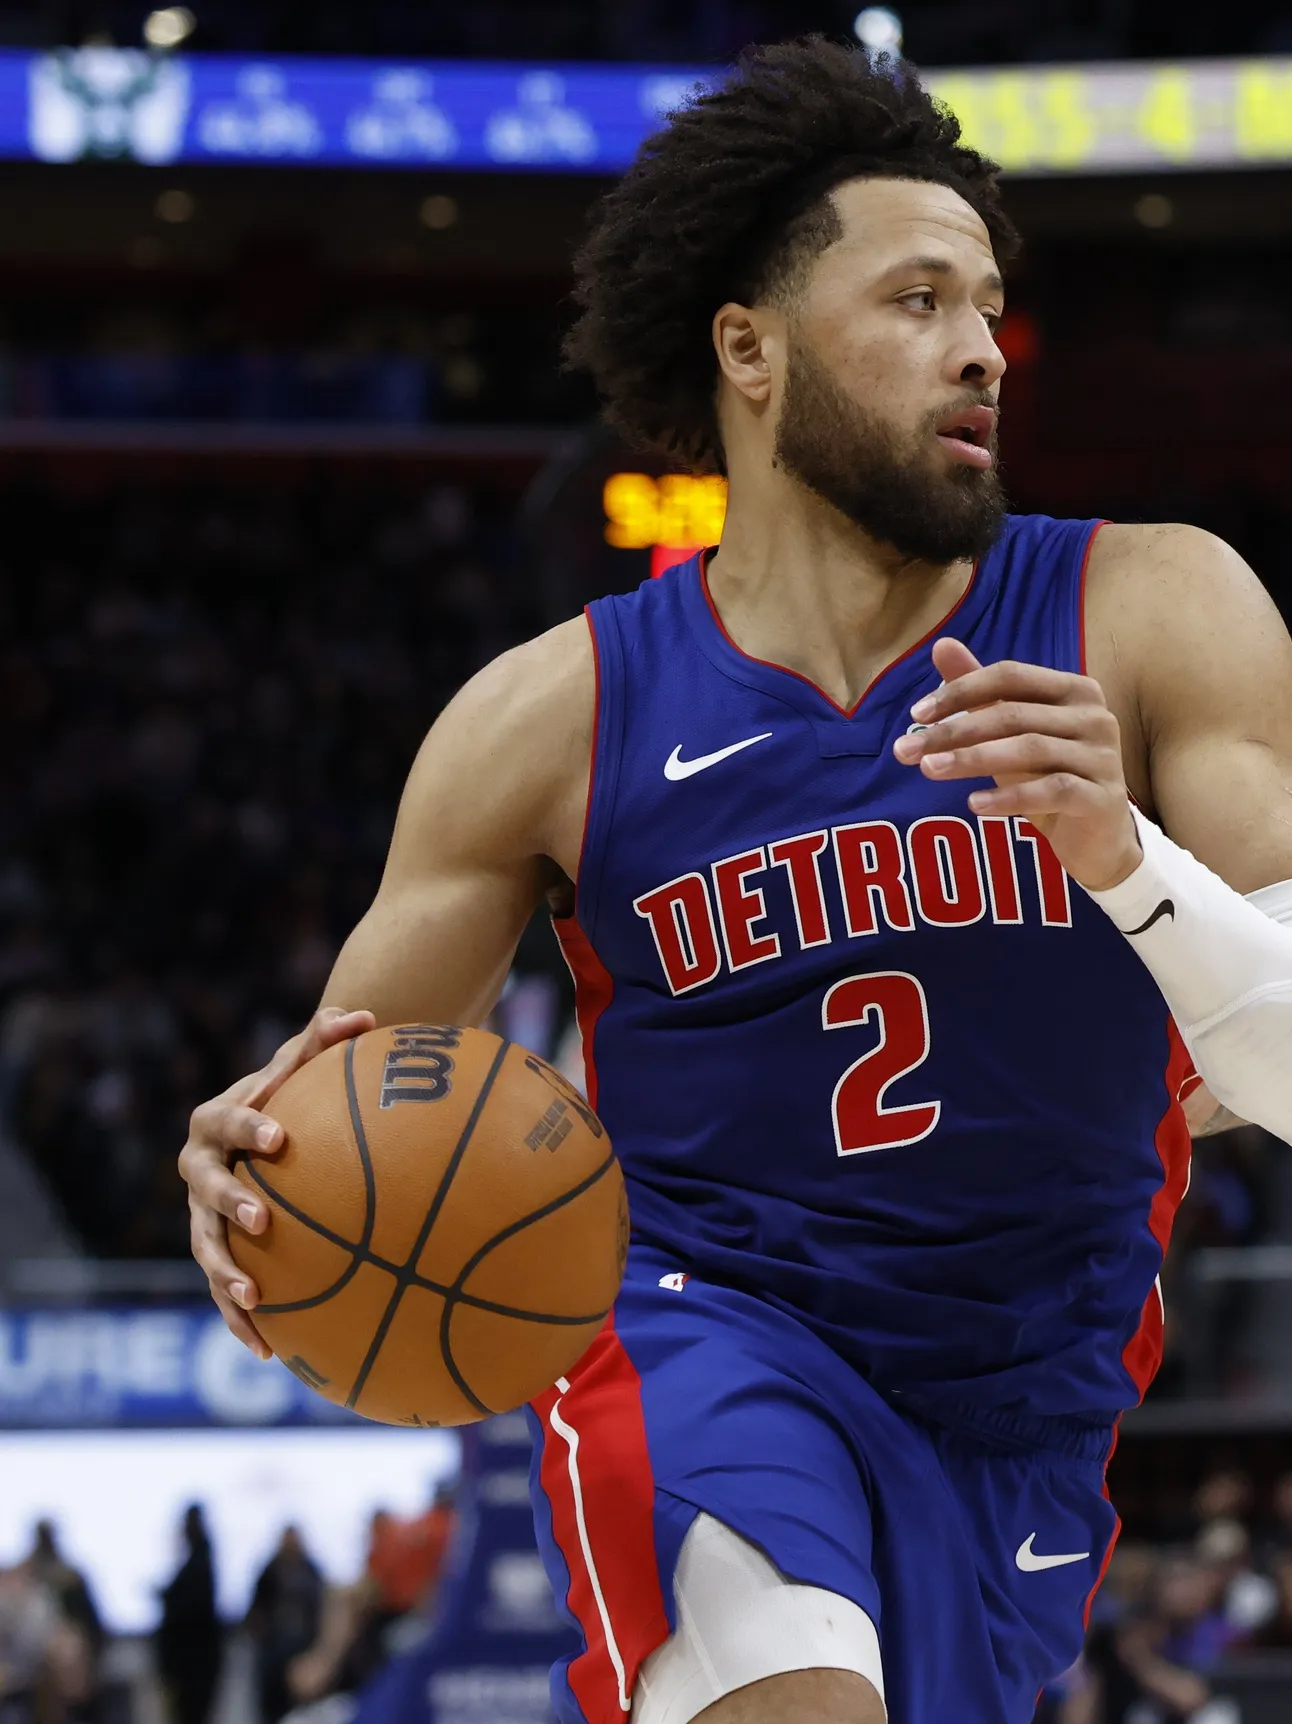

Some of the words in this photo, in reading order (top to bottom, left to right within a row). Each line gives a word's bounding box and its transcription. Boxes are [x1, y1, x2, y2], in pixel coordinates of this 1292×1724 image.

[633, 815, 1073, 997] DETROIT
[379, 1023, 463, 1110] Wil
[821, 970, 941, 1157] 2
